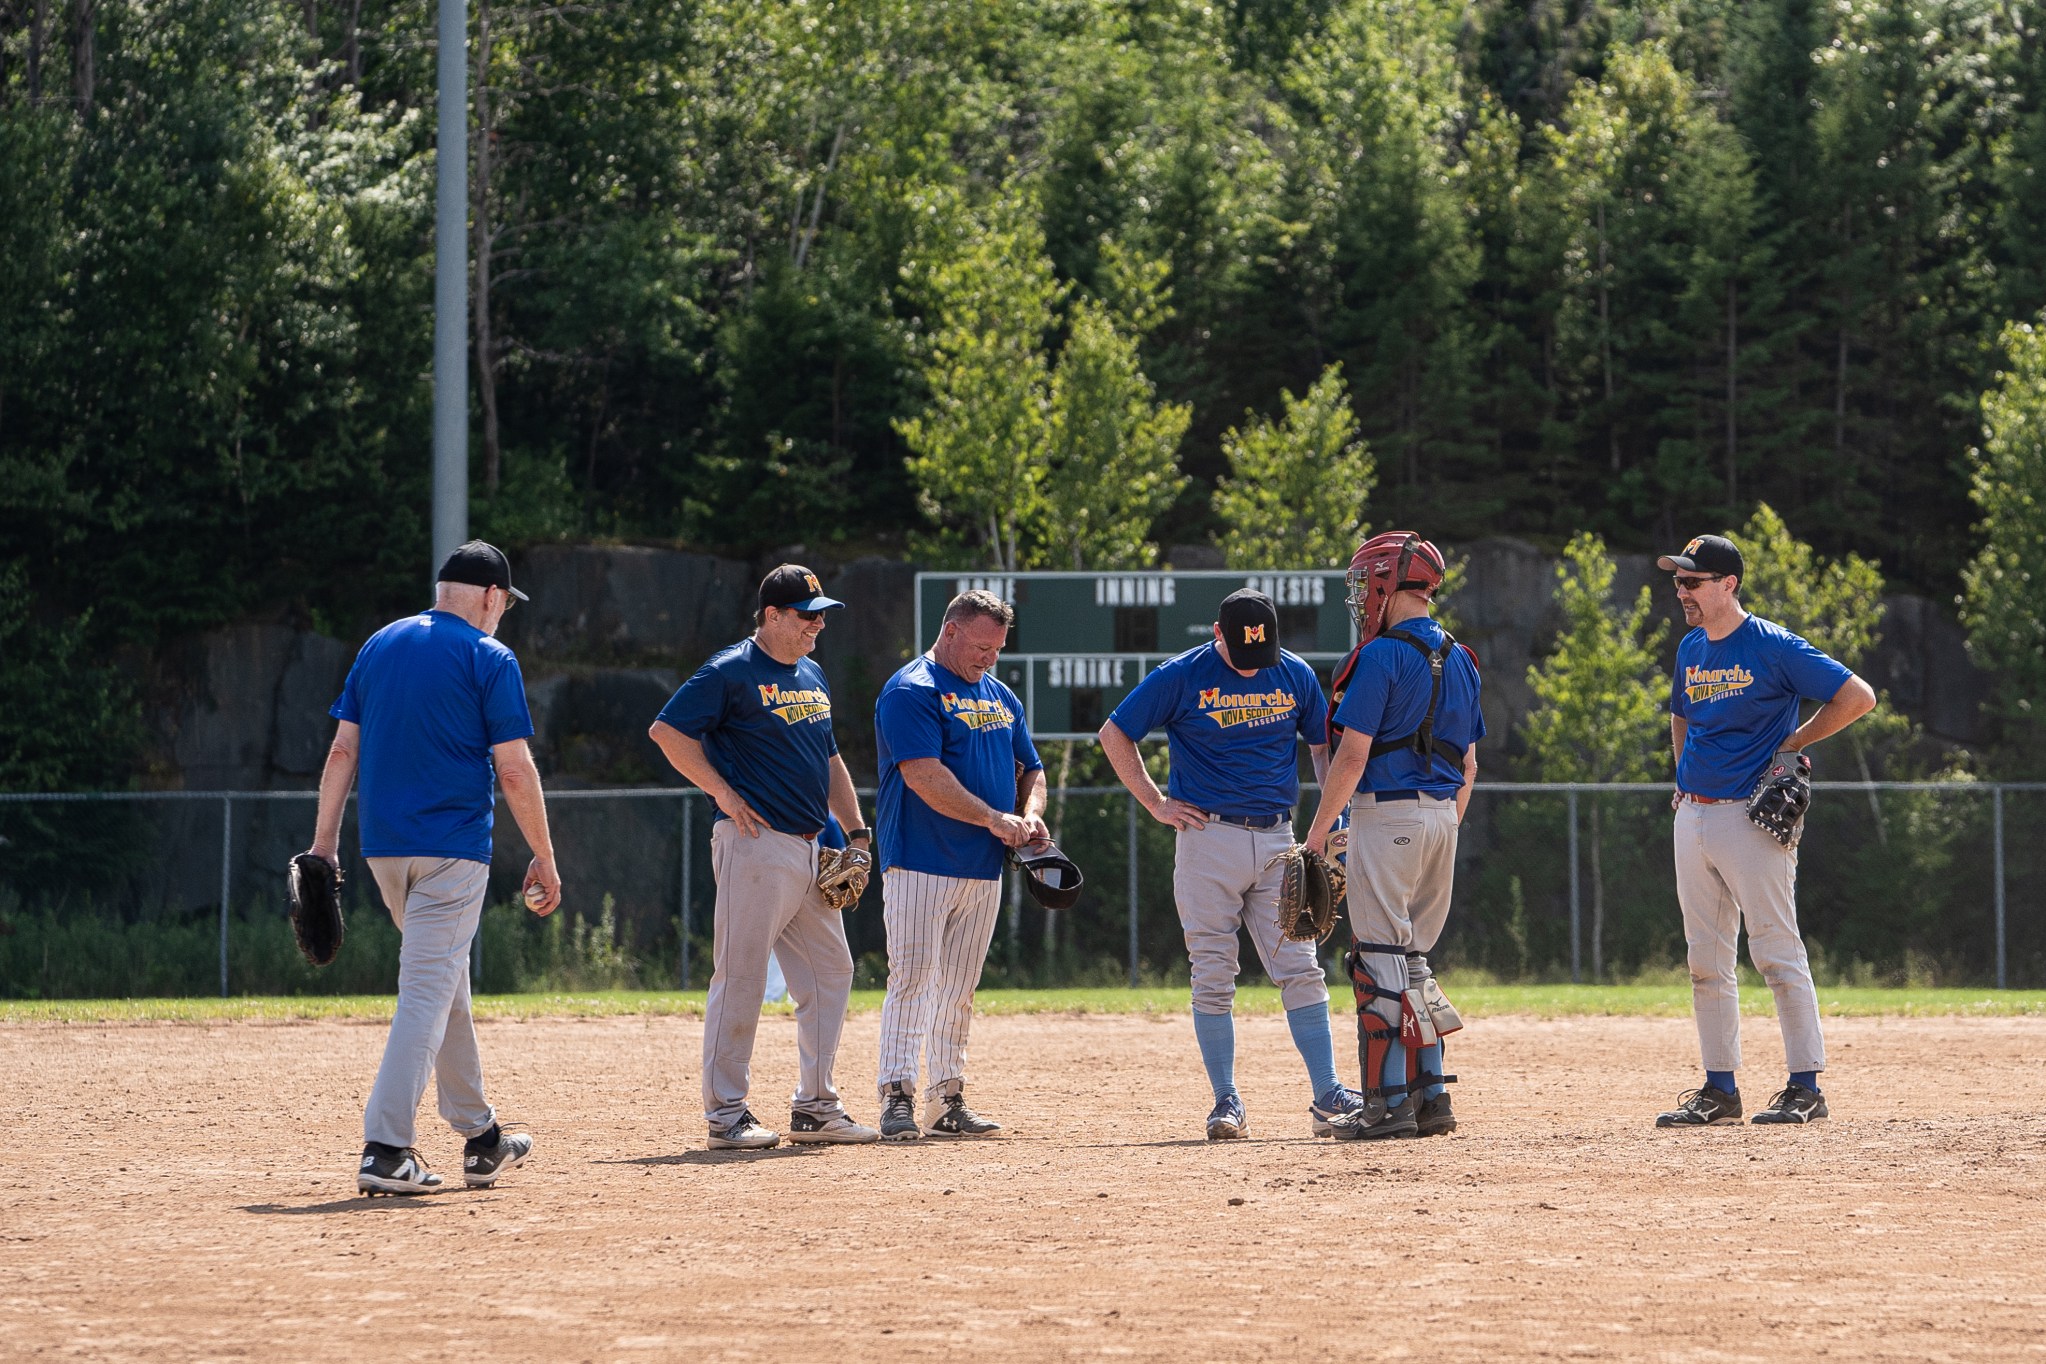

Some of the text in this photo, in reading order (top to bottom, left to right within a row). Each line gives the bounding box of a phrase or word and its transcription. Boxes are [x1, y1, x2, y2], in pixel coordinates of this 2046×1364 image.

[803, 574, 823, 593] M
[1095, 577, 1176, 606] INNING
[1244, 624, 1266, 644] M
[1048, 658, 1124, 688] STRIKE
[1685, 664, 1754, 687] Monarchs
[1198, 687, 1296, 709] Monarchs
[1710, 689, 1744, 704] BASEBALL
[1221, 708, 1274, 728] NOVA SCOTIA
[1248, 712, 1290, 728] BASEBALL
